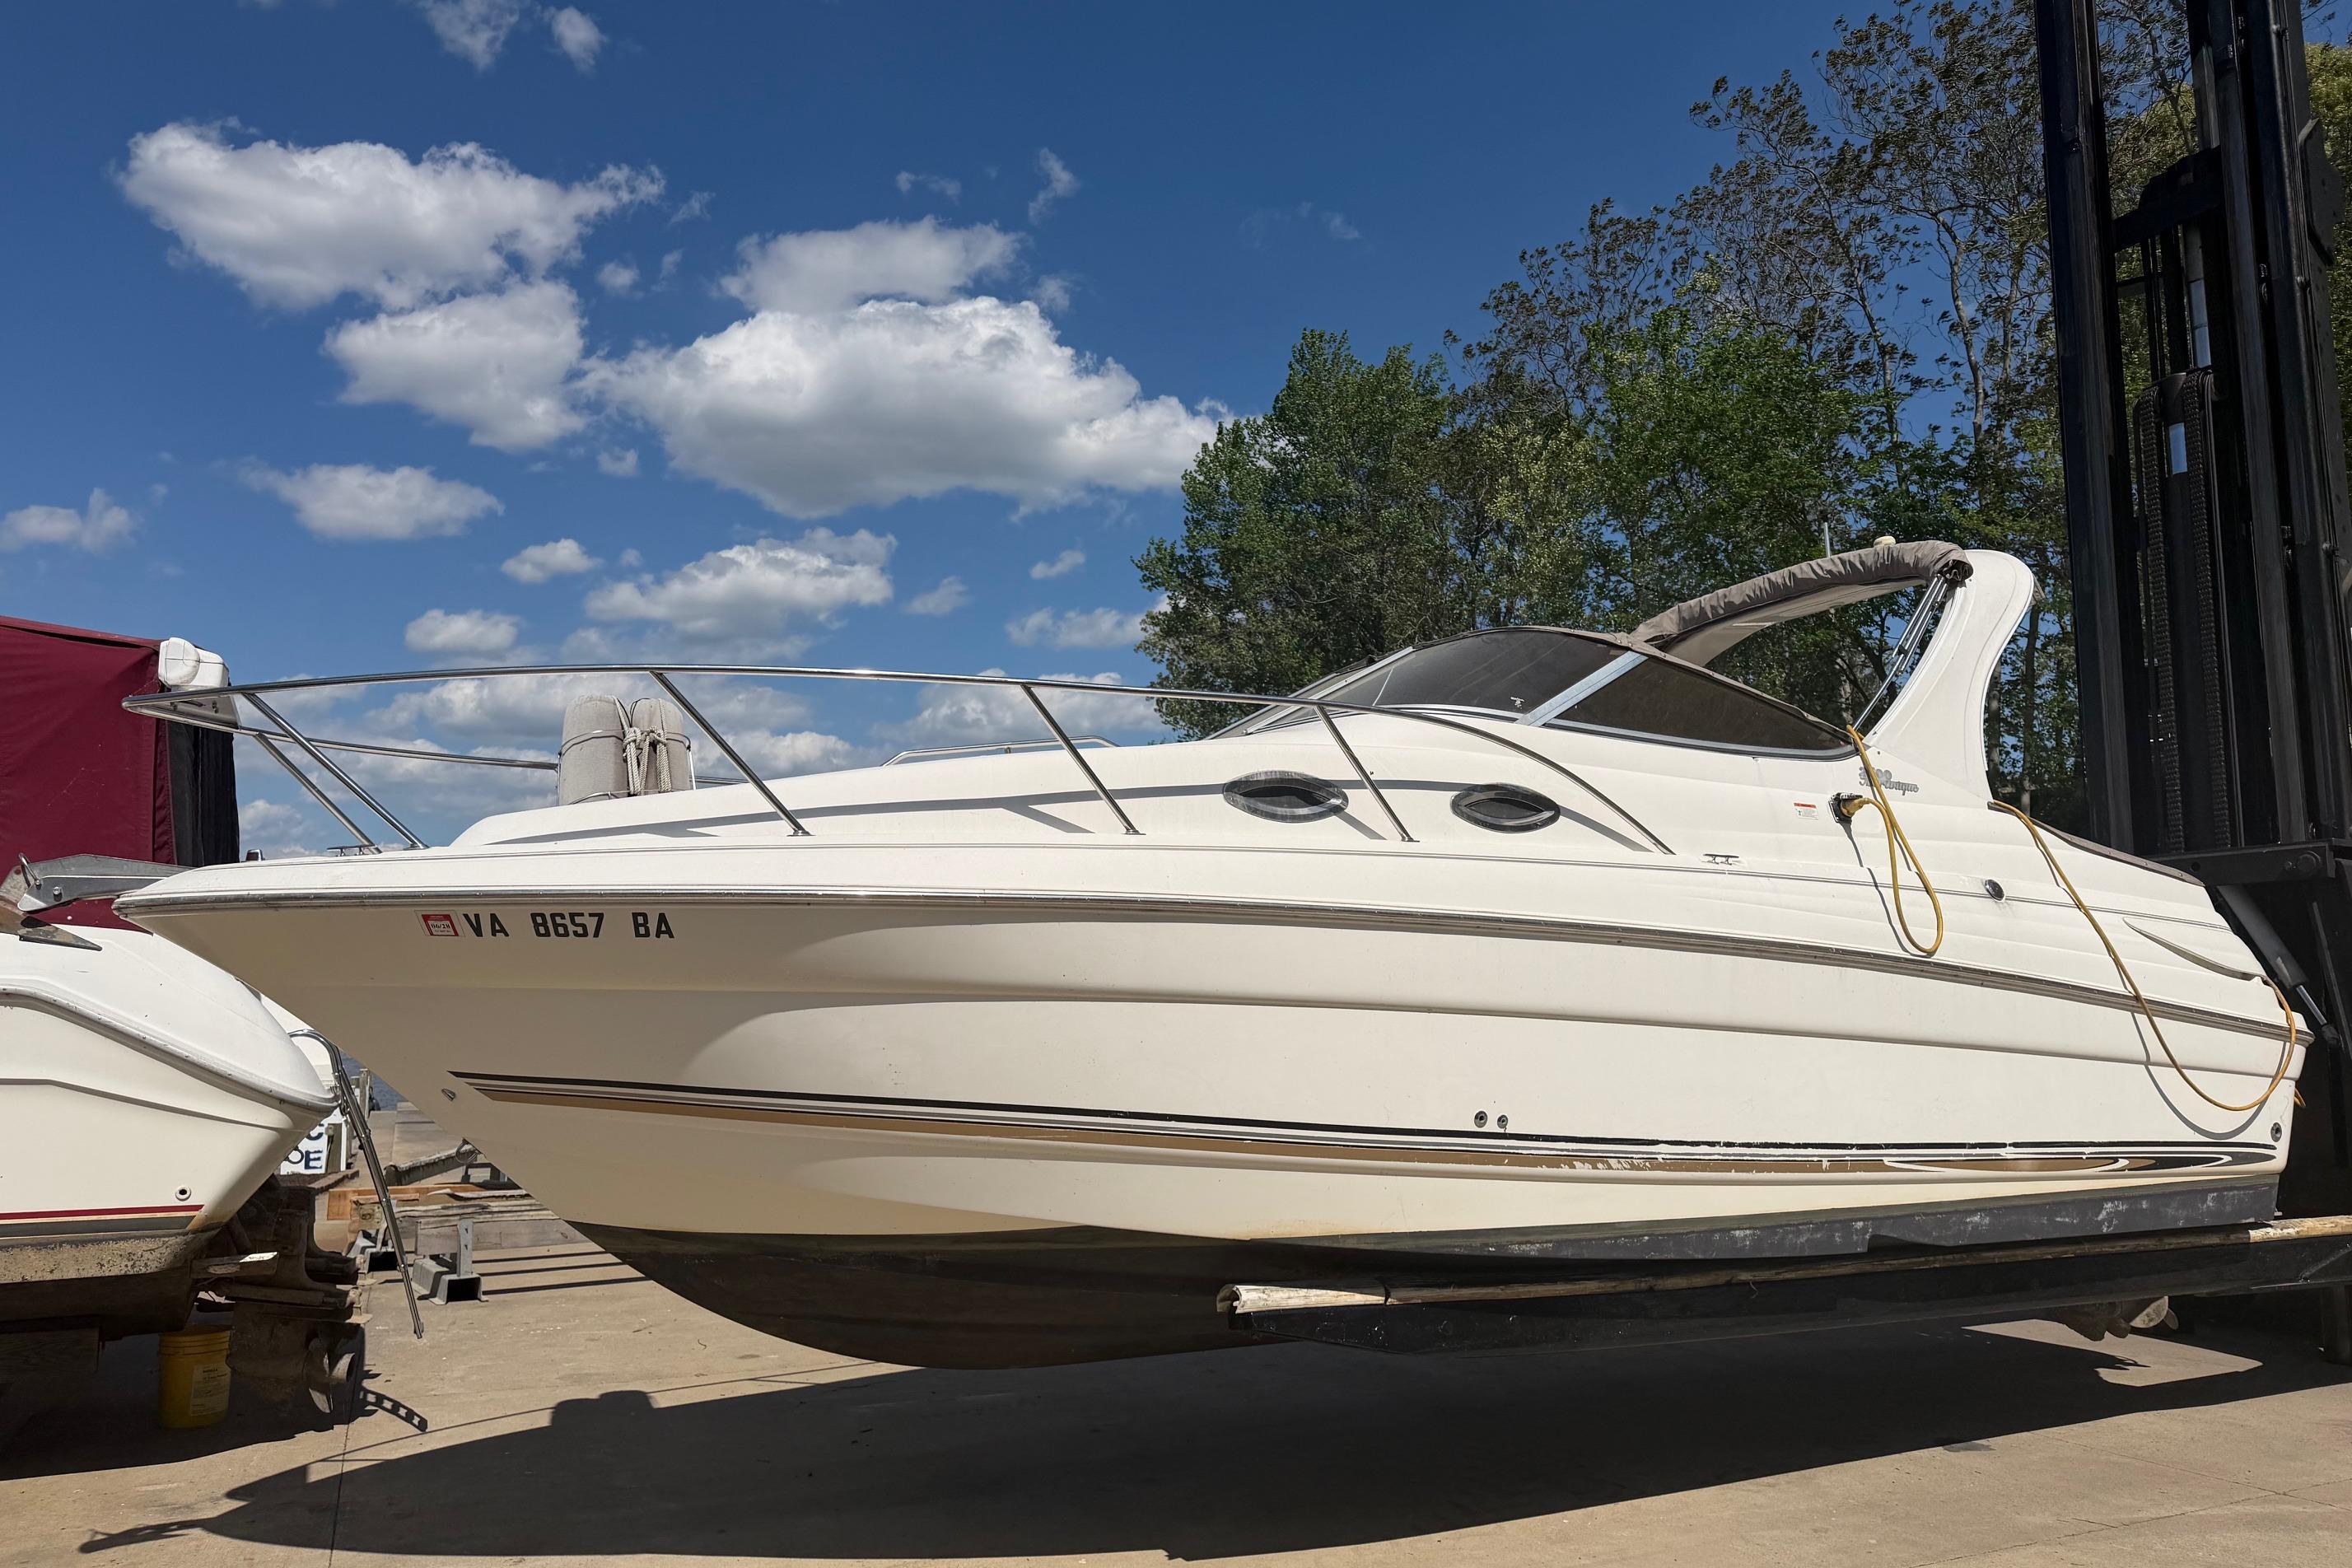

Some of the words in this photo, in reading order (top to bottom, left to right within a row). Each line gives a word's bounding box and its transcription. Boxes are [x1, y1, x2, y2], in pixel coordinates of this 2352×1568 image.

[463, 913, 509, 937] VA
[530, 912, 604, 937] 8657
[632, 912, 674, 938] BA
